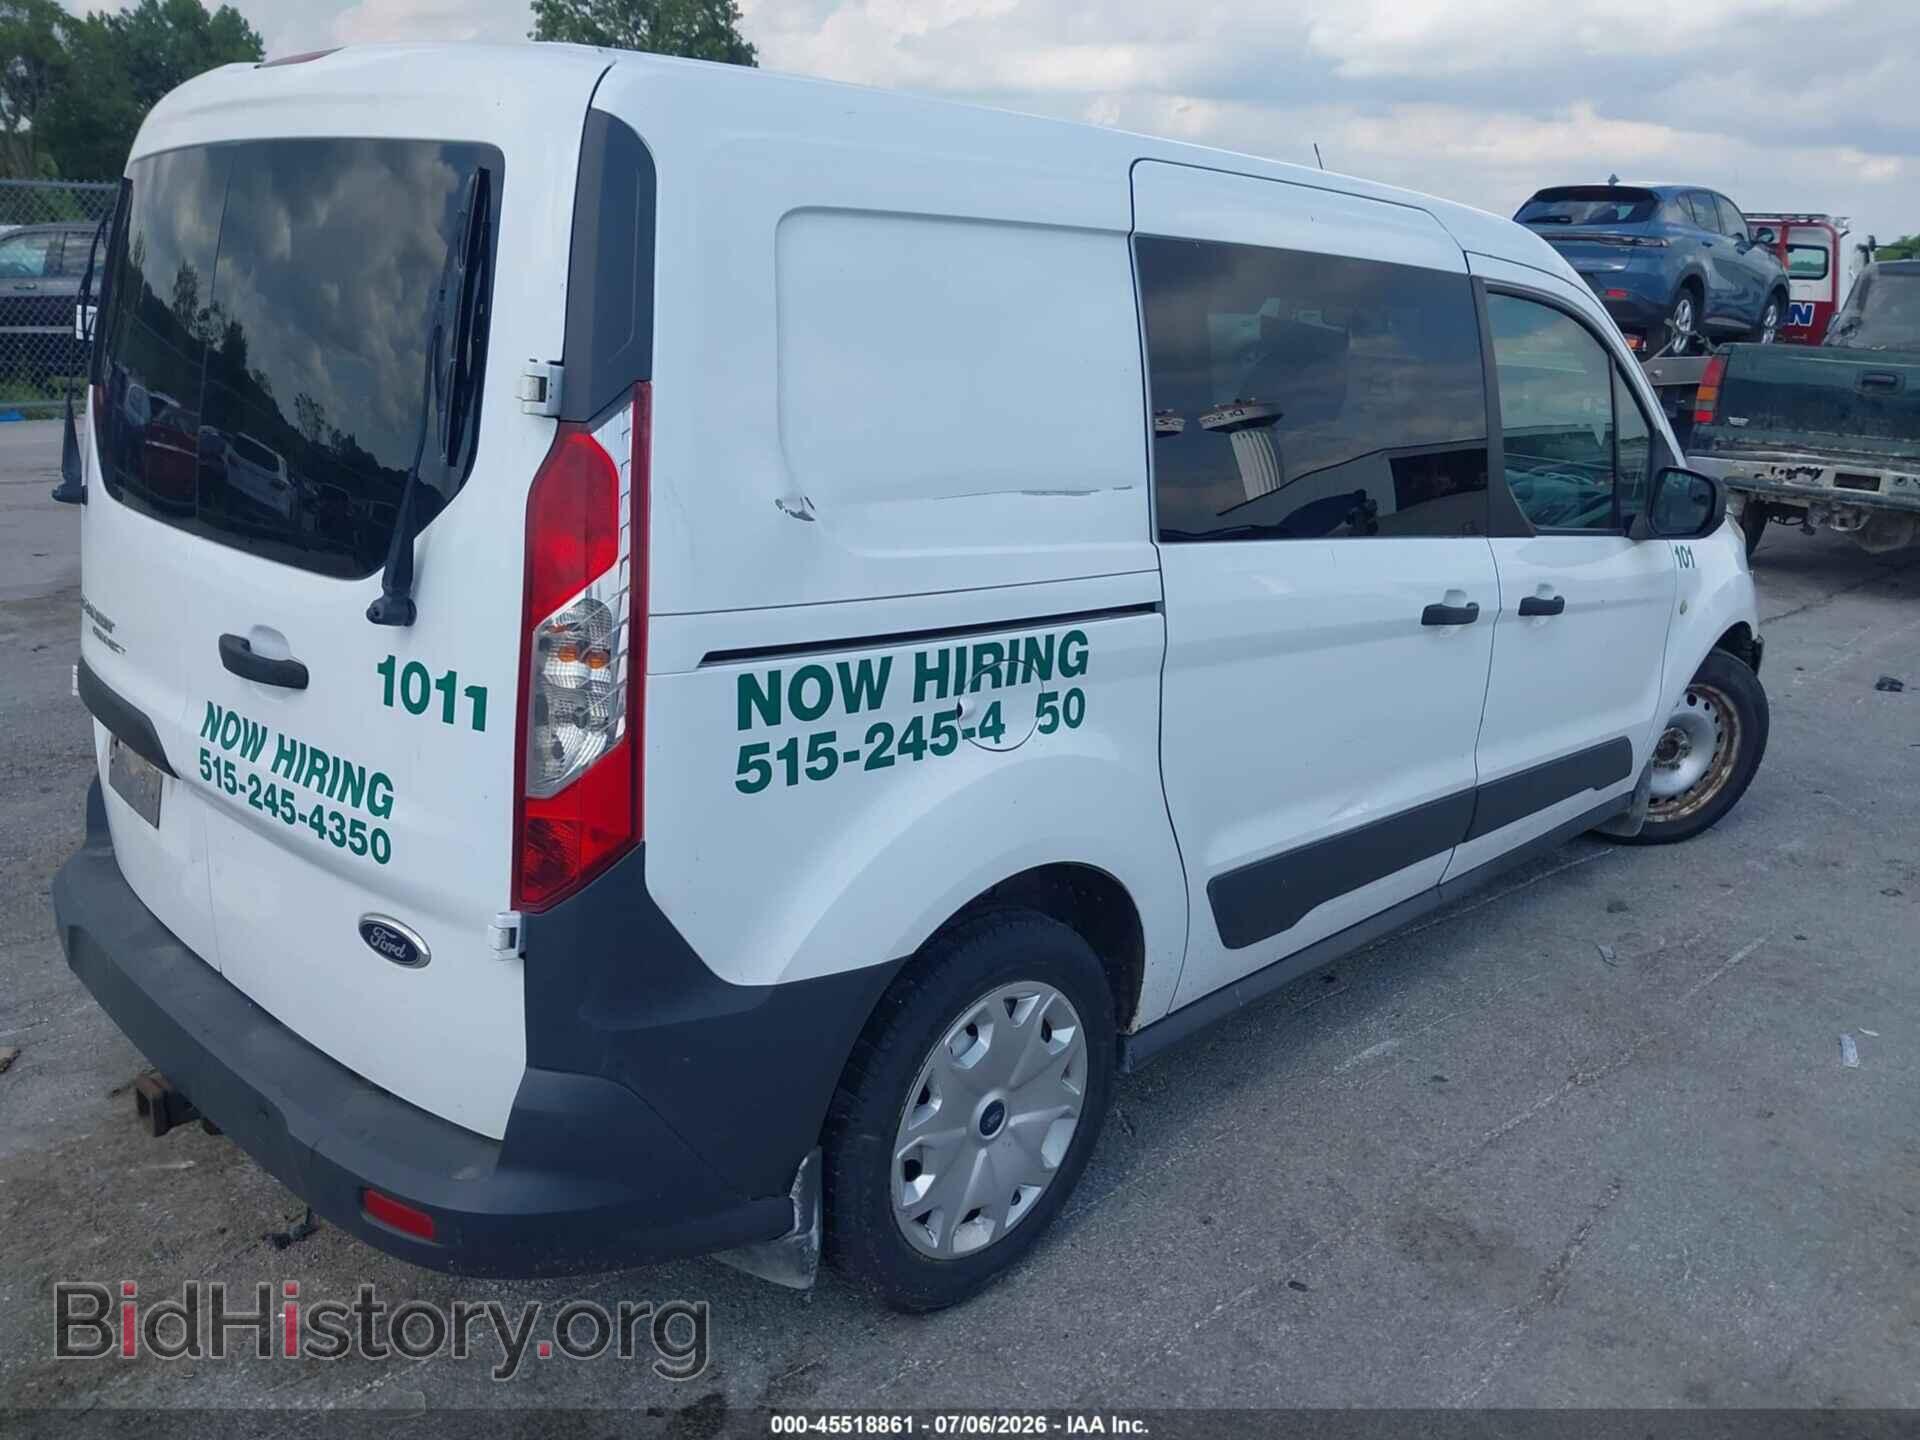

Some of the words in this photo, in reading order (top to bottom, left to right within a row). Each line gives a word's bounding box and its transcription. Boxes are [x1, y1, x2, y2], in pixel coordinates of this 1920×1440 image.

[377, 654, 488, 732] 1011
[737, 655, 893, 731] NOW
[912, 629, 1089, 703] HIRING
[199, 747, 392, 865] 515-245-4350
[200, 700, 267, 763] NOW
[270, 732, 394, 819] HIRING
[370, 926, 407, 959] Ford
